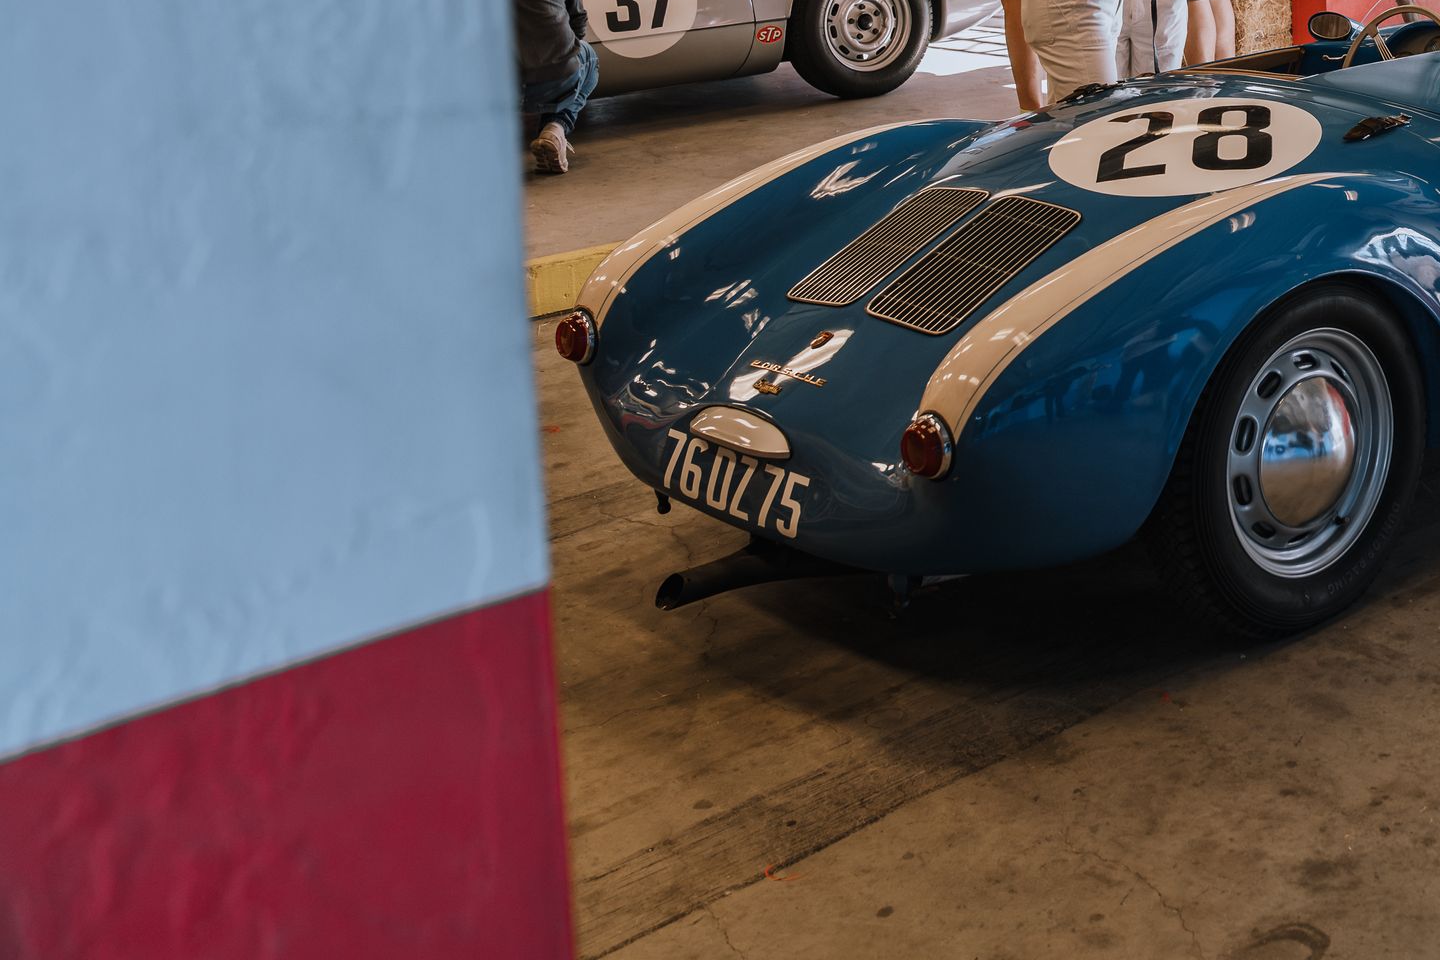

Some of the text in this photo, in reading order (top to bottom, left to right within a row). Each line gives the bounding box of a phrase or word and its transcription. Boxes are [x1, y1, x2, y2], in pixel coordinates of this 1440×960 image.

[758, 26, 782, 42] STP
[1096, 105, 1272, 183] 28
[750, 360, 827, 387] PORSCHE
